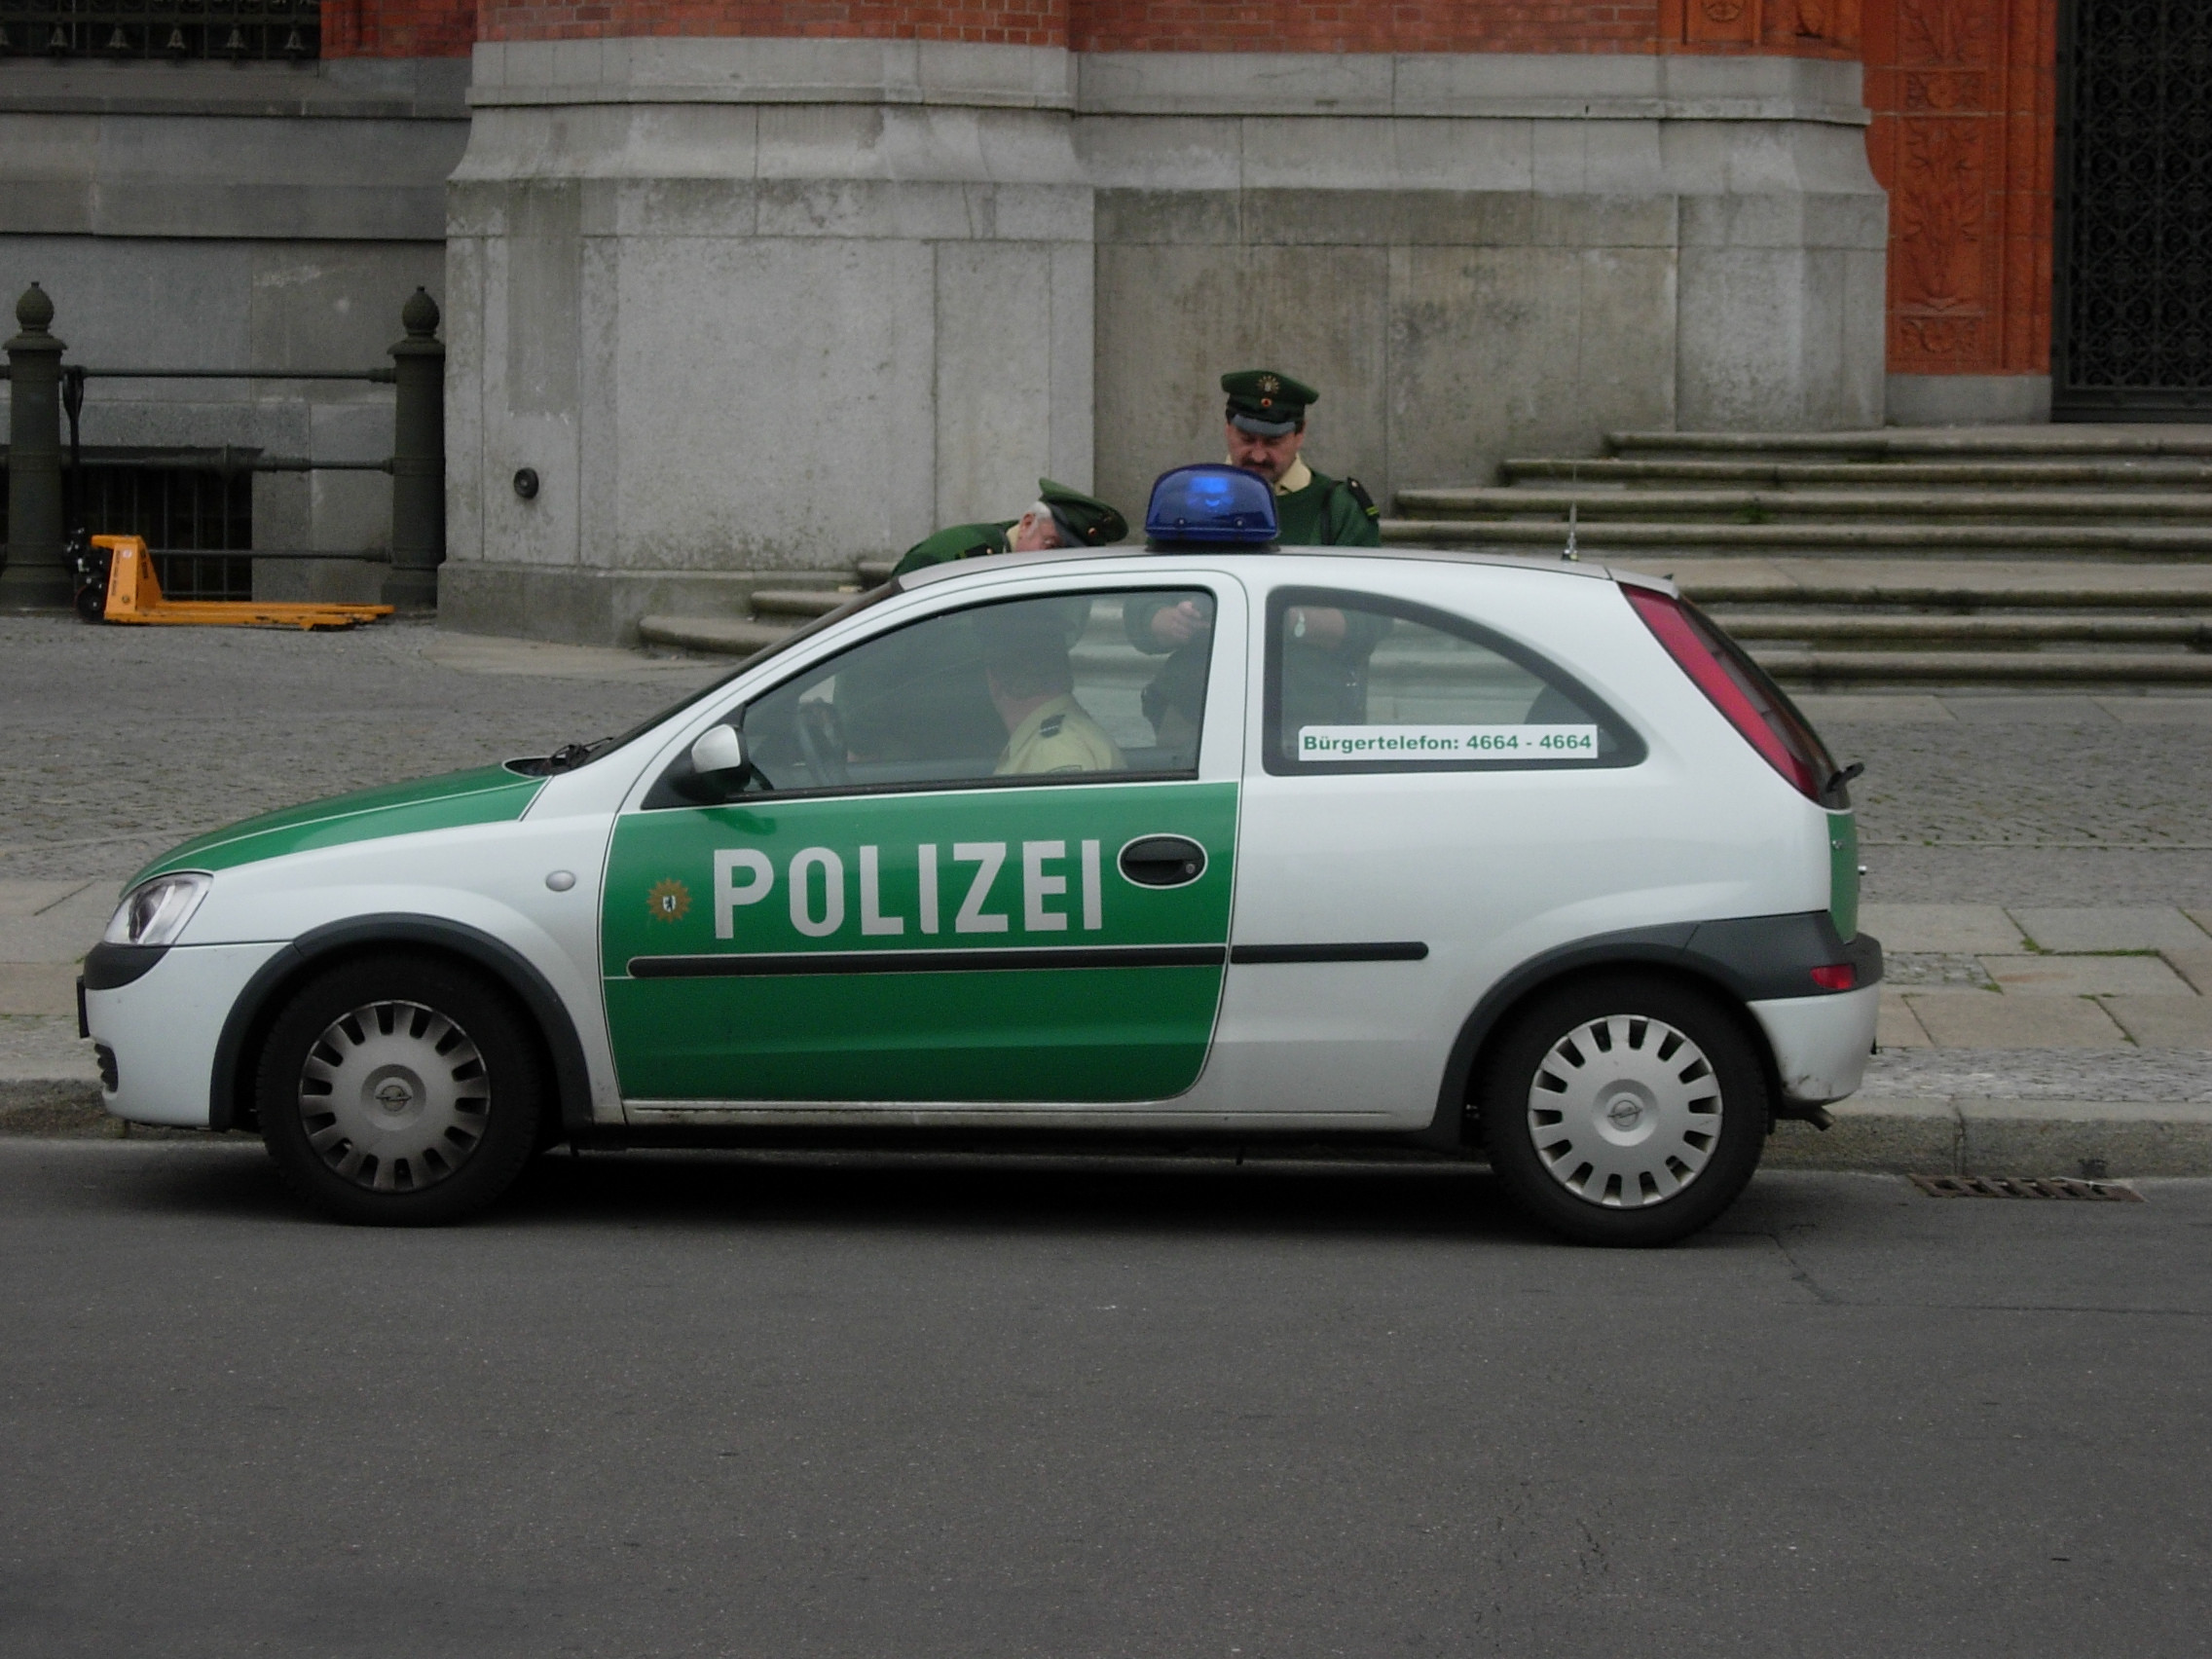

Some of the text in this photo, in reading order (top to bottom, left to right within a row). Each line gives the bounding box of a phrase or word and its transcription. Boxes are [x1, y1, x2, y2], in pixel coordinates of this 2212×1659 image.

[1304, 735, 1458, 754] Bürgertelefon:
[1466, 734, 1519, 750] 4664
[1539, 733, 1592, 750] 4664
[714, 839, 1102, 940] POLIZEI
